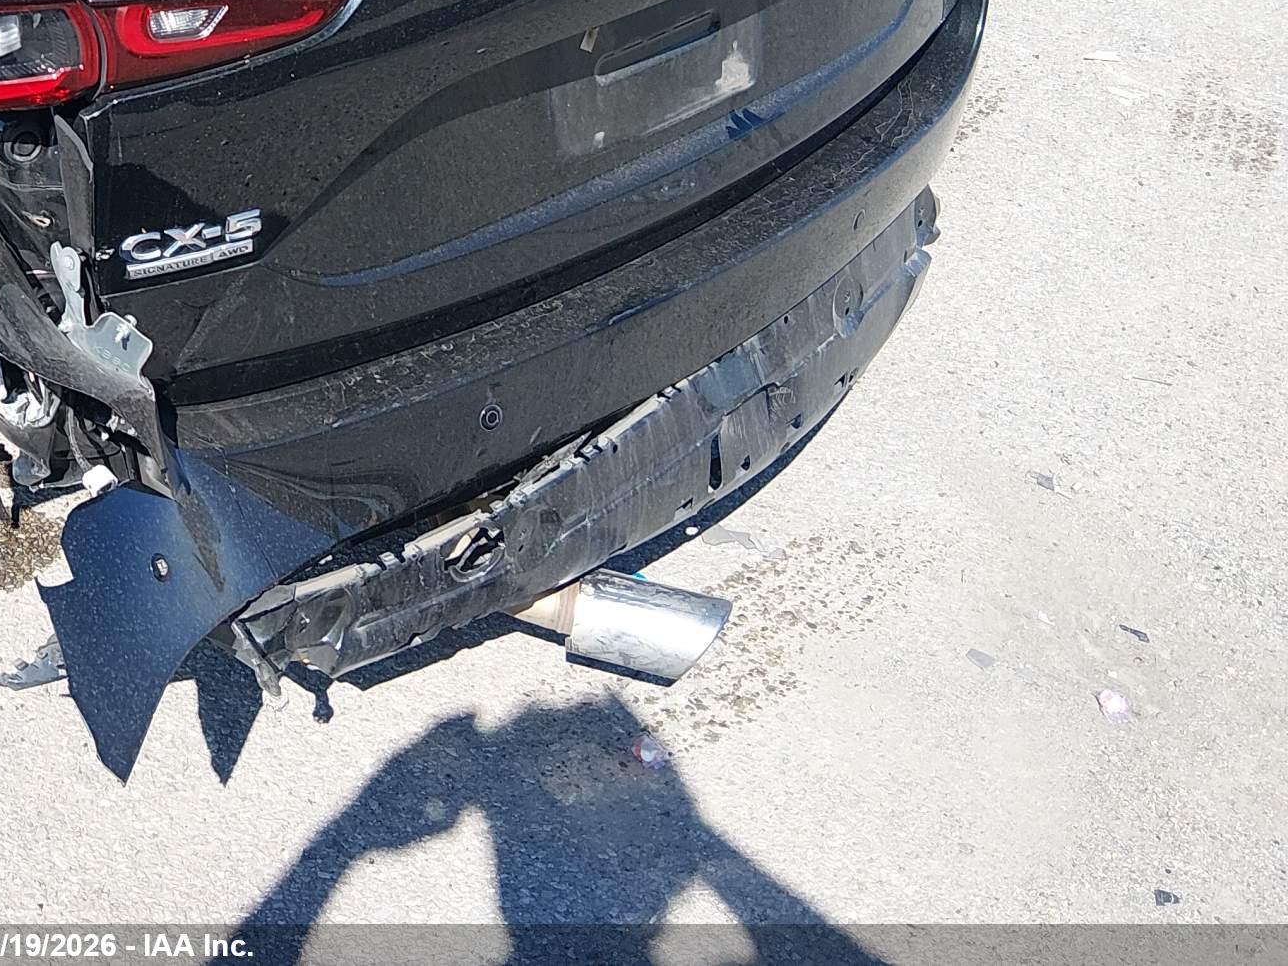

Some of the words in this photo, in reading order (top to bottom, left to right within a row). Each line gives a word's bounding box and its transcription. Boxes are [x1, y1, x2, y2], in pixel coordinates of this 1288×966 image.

[119, 209, 262, 262] CX-5
[132, 256, 209, 277] SIGNATURE
[218, 244, 249, 258] AWD
